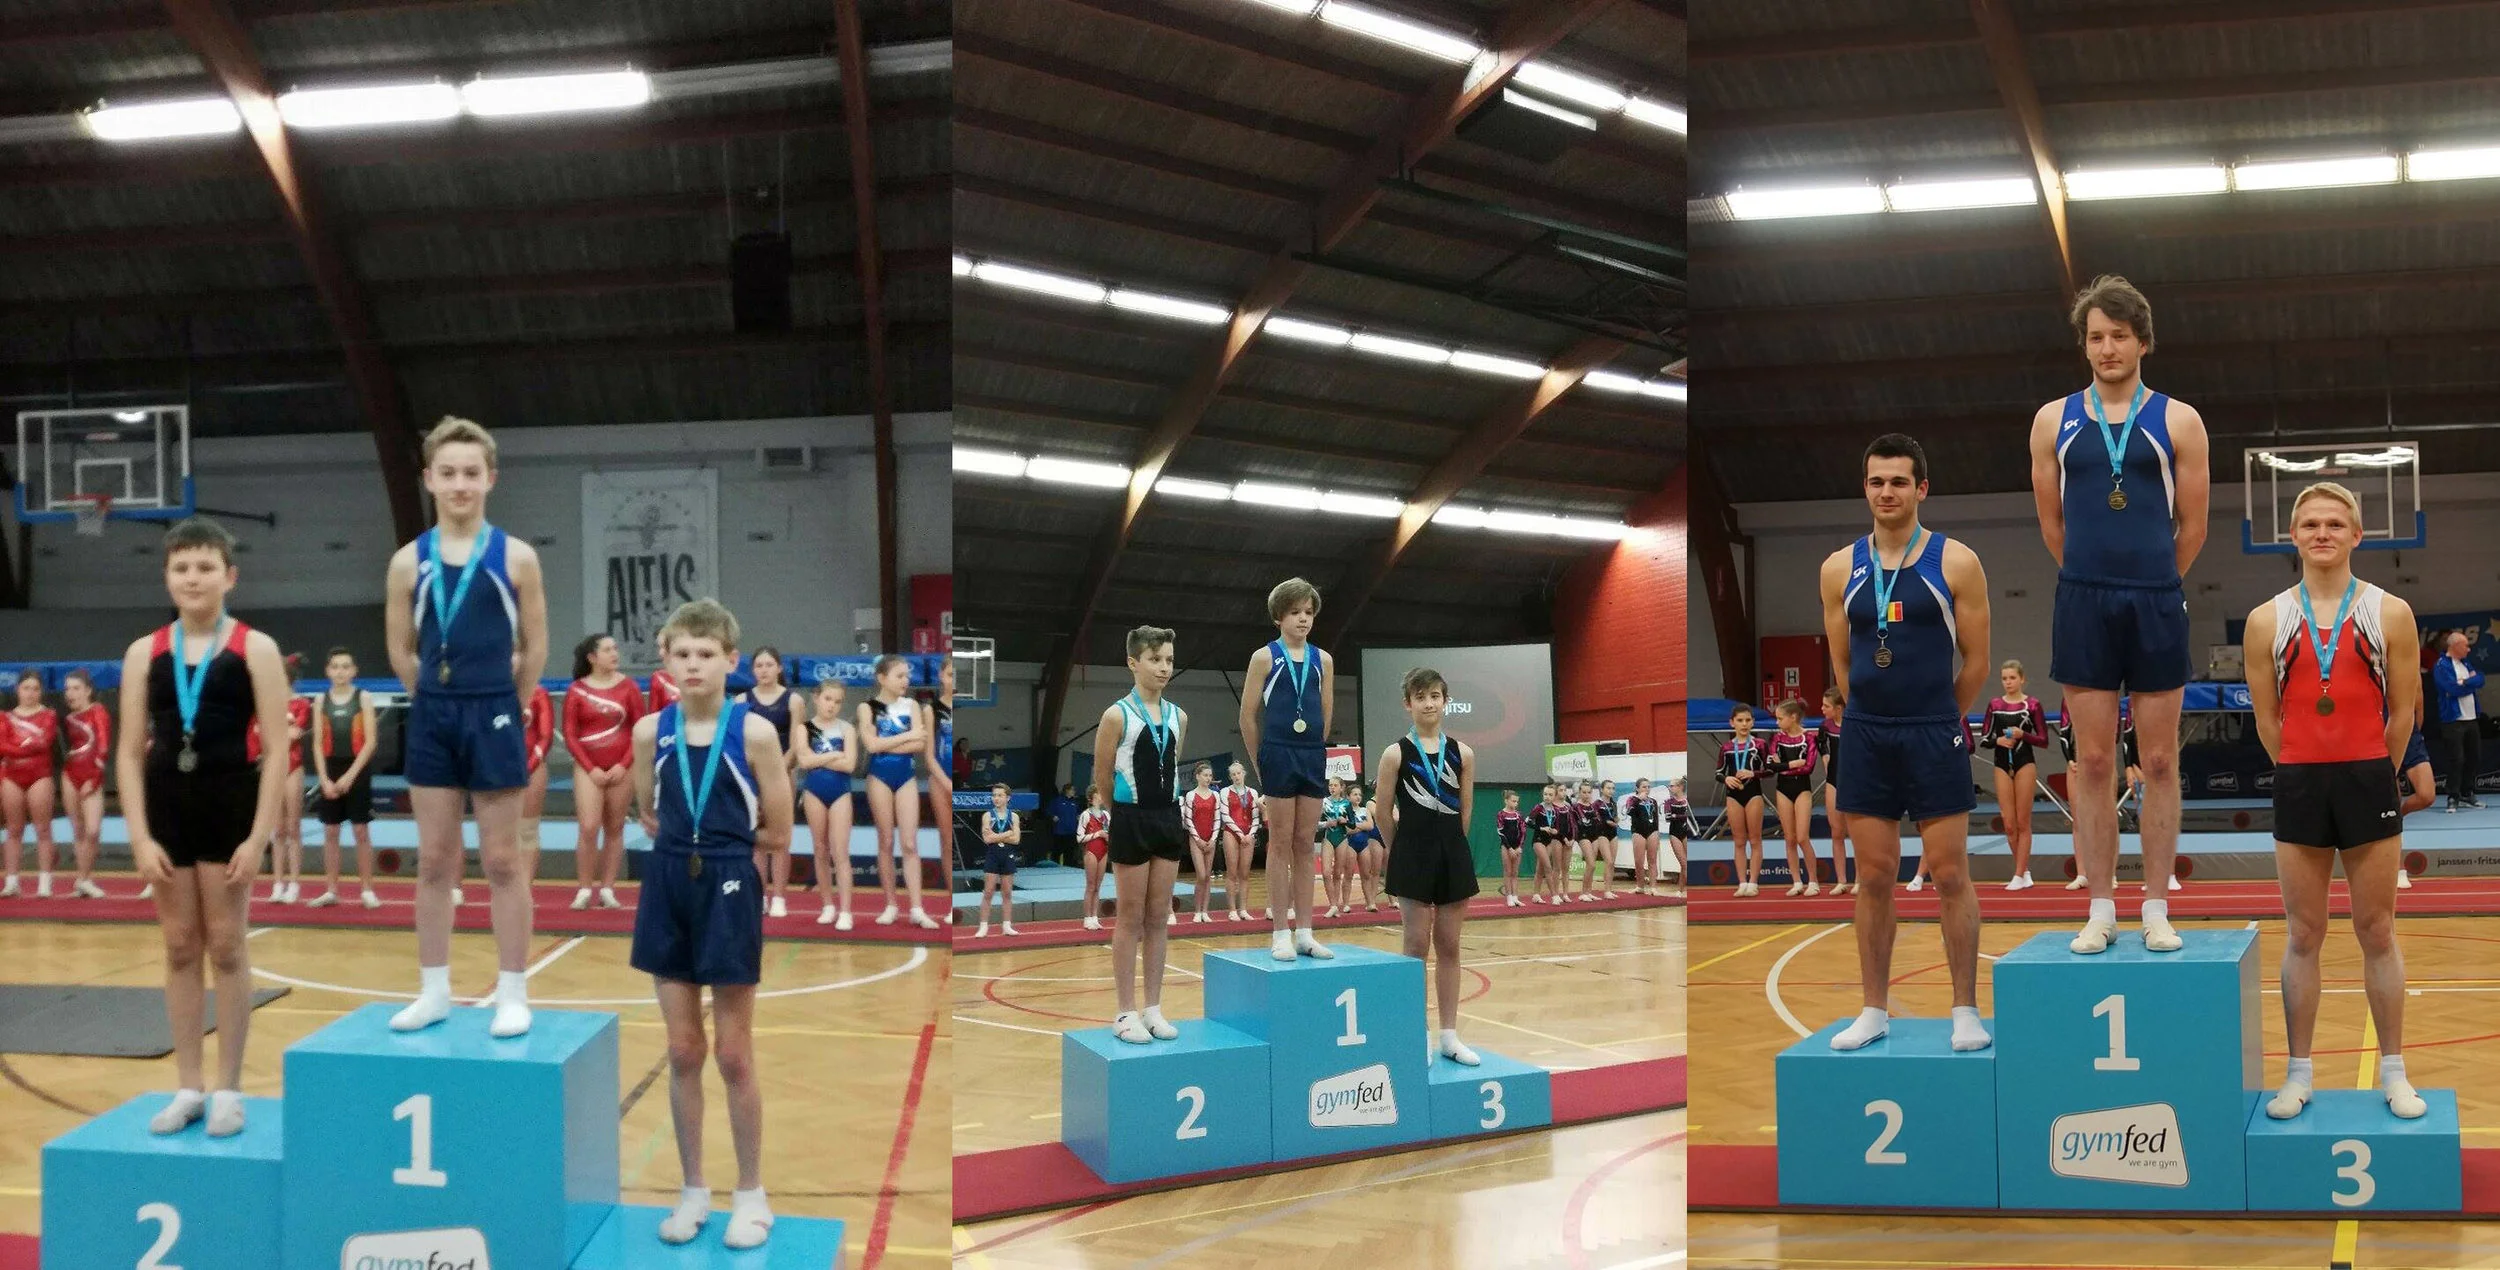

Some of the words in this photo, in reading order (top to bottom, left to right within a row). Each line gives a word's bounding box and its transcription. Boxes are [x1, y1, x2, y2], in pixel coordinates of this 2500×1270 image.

[1787, 670, 1797, 684] H
[1443, 702, 1472, 716] JITSU
[1335, 988, 1367, 1047] 1
[2092, 994, 2141, 1071] 1
[1176, 1086, 1207, 1140] 2
[1316, 1080, 1384, 1116] gymfed
[1480, 1081, 1506, 1129] 3
[392, 1093, 447, 1187] 1
[1865, 1099, 1907, 1164] 2
[2061, 1123, 2168, 1161] gymfed
[2128, 1158, 2142, 1168] we
[2143, 1158, 2157, 1168] are
[2158, 1158, 2178, 1170] gym
[2331, 1139, 2376, 1207] 3
[136, 1202, 184, 1270] 2
